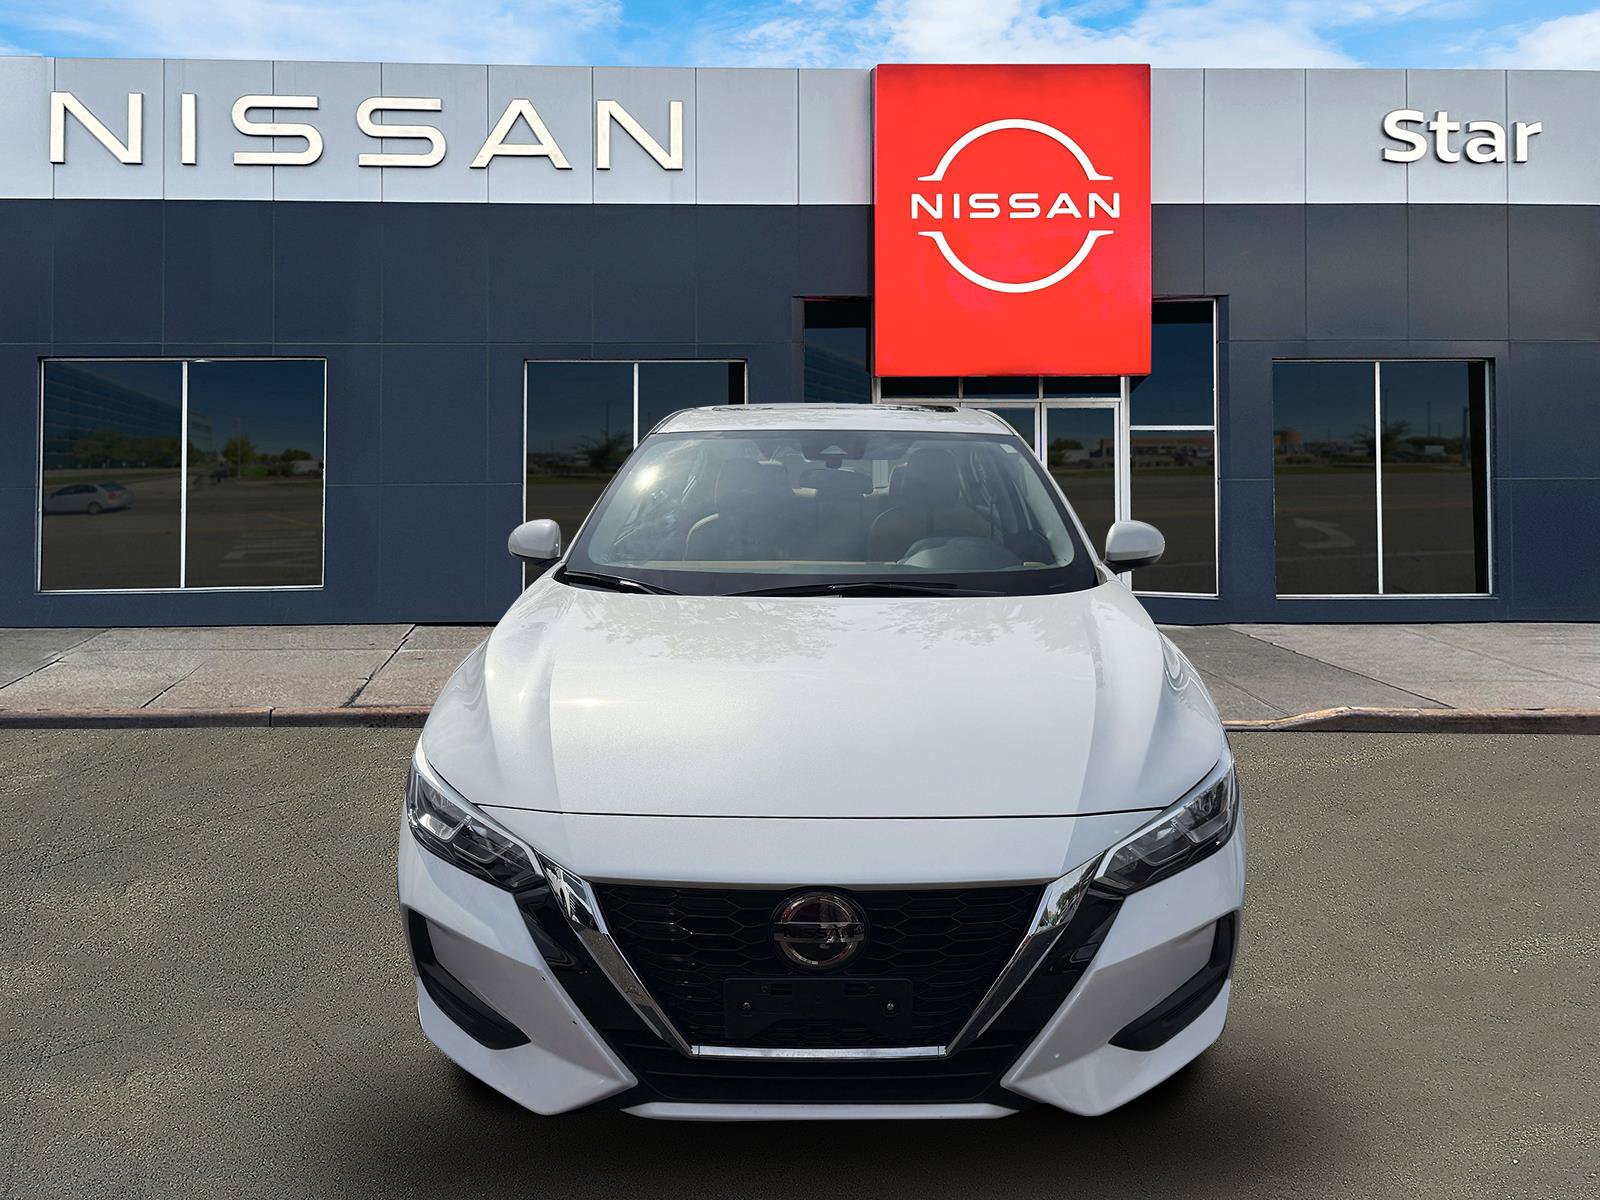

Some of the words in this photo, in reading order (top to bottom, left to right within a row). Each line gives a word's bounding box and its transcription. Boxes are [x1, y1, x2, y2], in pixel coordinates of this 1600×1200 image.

[49, 91, 684, 169] NISSAN
[1382, 108, 1543, 163] Star
[911, 193, 1121, 220] NISSAN
